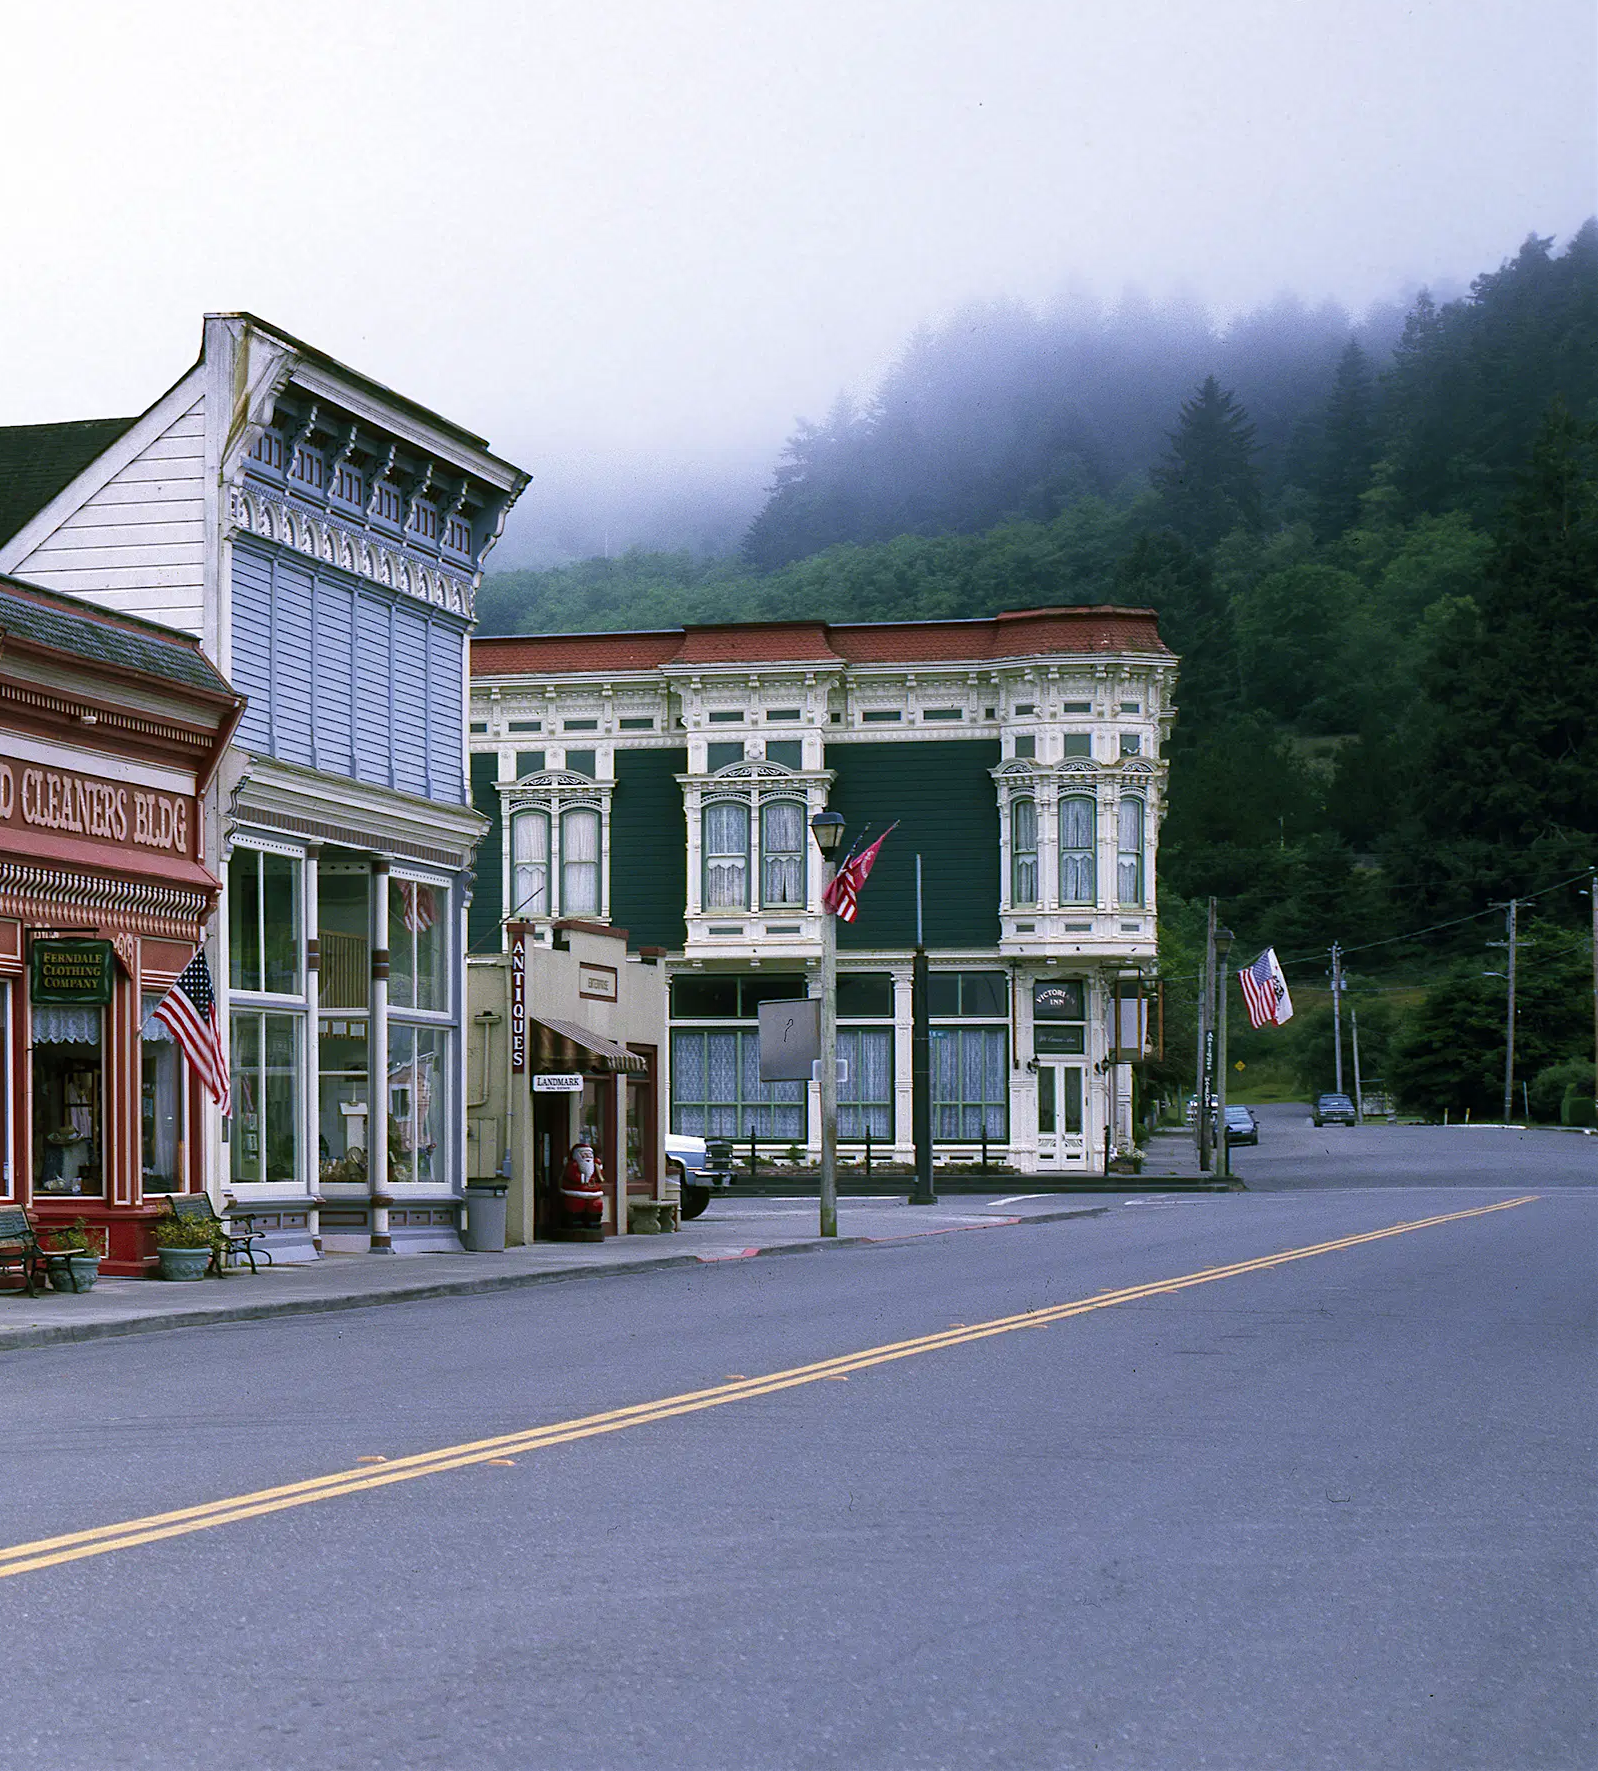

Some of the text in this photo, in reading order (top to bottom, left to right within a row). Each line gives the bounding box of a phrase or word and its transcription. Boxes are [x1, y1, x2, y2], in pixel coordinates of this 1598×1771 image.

[21, 767, 128, 841] CLEANERS
[133, 791, 188, 854] BLDG
[43, 952, 103, 964] FERNDALE
[42, 964, 102, 977] CLOTHING
[44, 976, 100, 989] COMPANY
[513, 940, 525, 1067] ANTIQUES
[1049, 998, 1065, 1006] INN
[537, 1077, 580, 1087] LANDMARK
